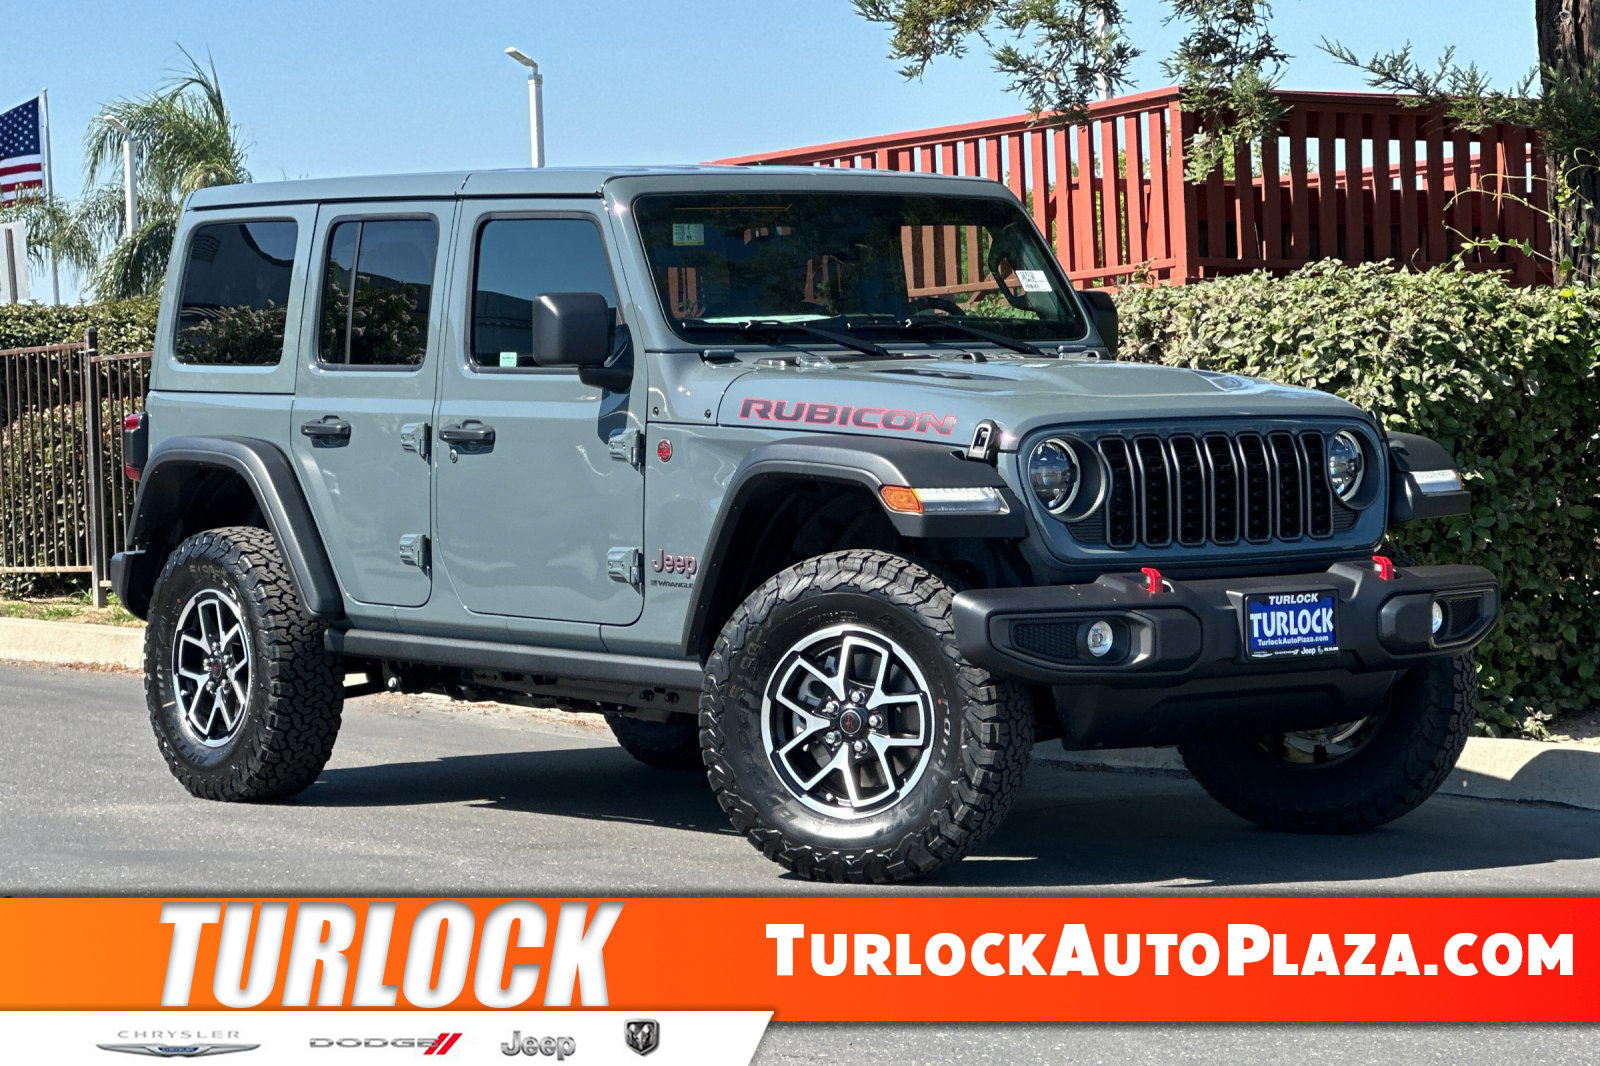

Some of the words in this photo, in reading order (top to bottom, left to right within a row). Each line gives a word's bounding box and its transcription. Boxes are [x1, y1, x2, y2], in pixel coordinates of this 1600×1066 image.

[740, 398, 957, 435] RUBICON
[651, 548, 697, 579] Jeep
[658, 580, 695, 589] WRANGLE
[1269, 593, 1318, 605] TURLOCK
[1250, 607, 1334, 637] TURLOCK
[1258, 635, 1329, 646] TurlockAutoPlaza.com
